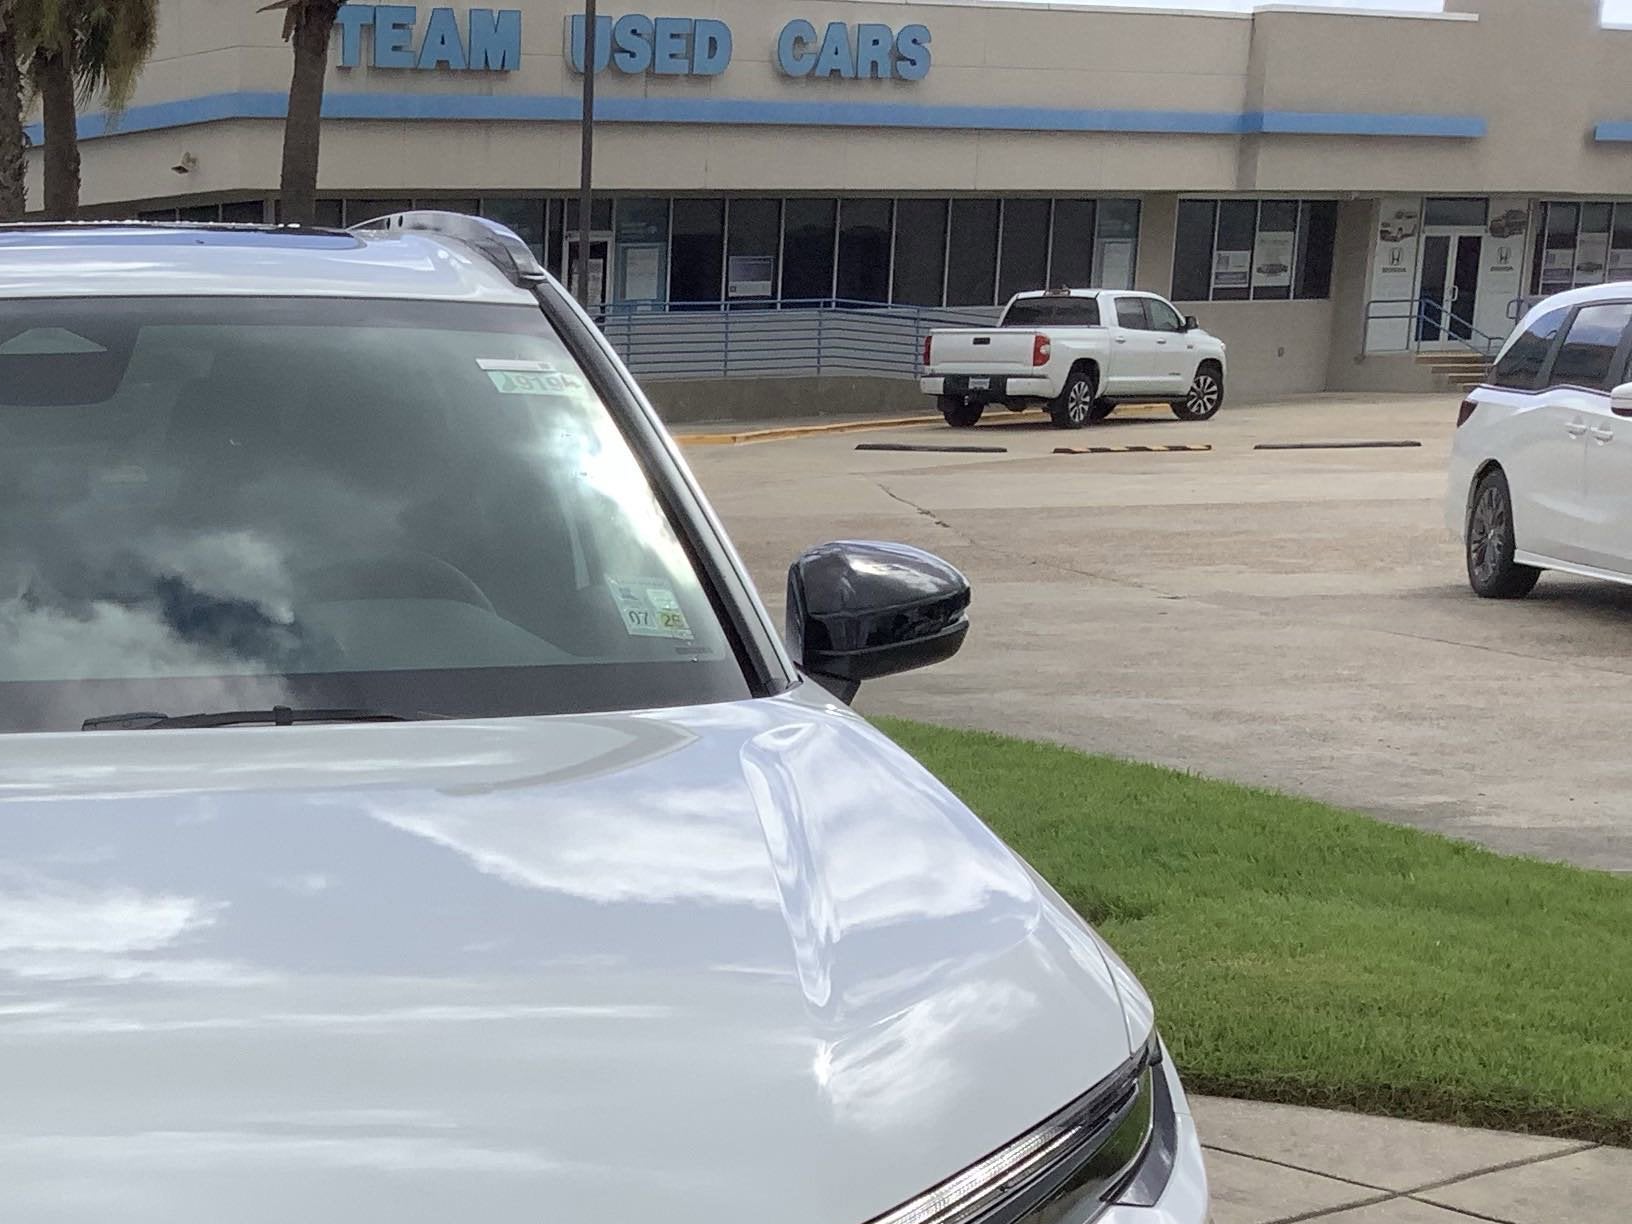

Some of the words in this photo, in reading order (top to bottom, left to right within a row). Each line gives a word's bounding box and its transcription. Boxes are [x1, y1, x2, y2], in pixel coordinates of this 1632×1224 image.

[336, 4, 523, 71] TEAM
[569, 13, 734, 77] USED
[776, 18, 933, 81] CARS
